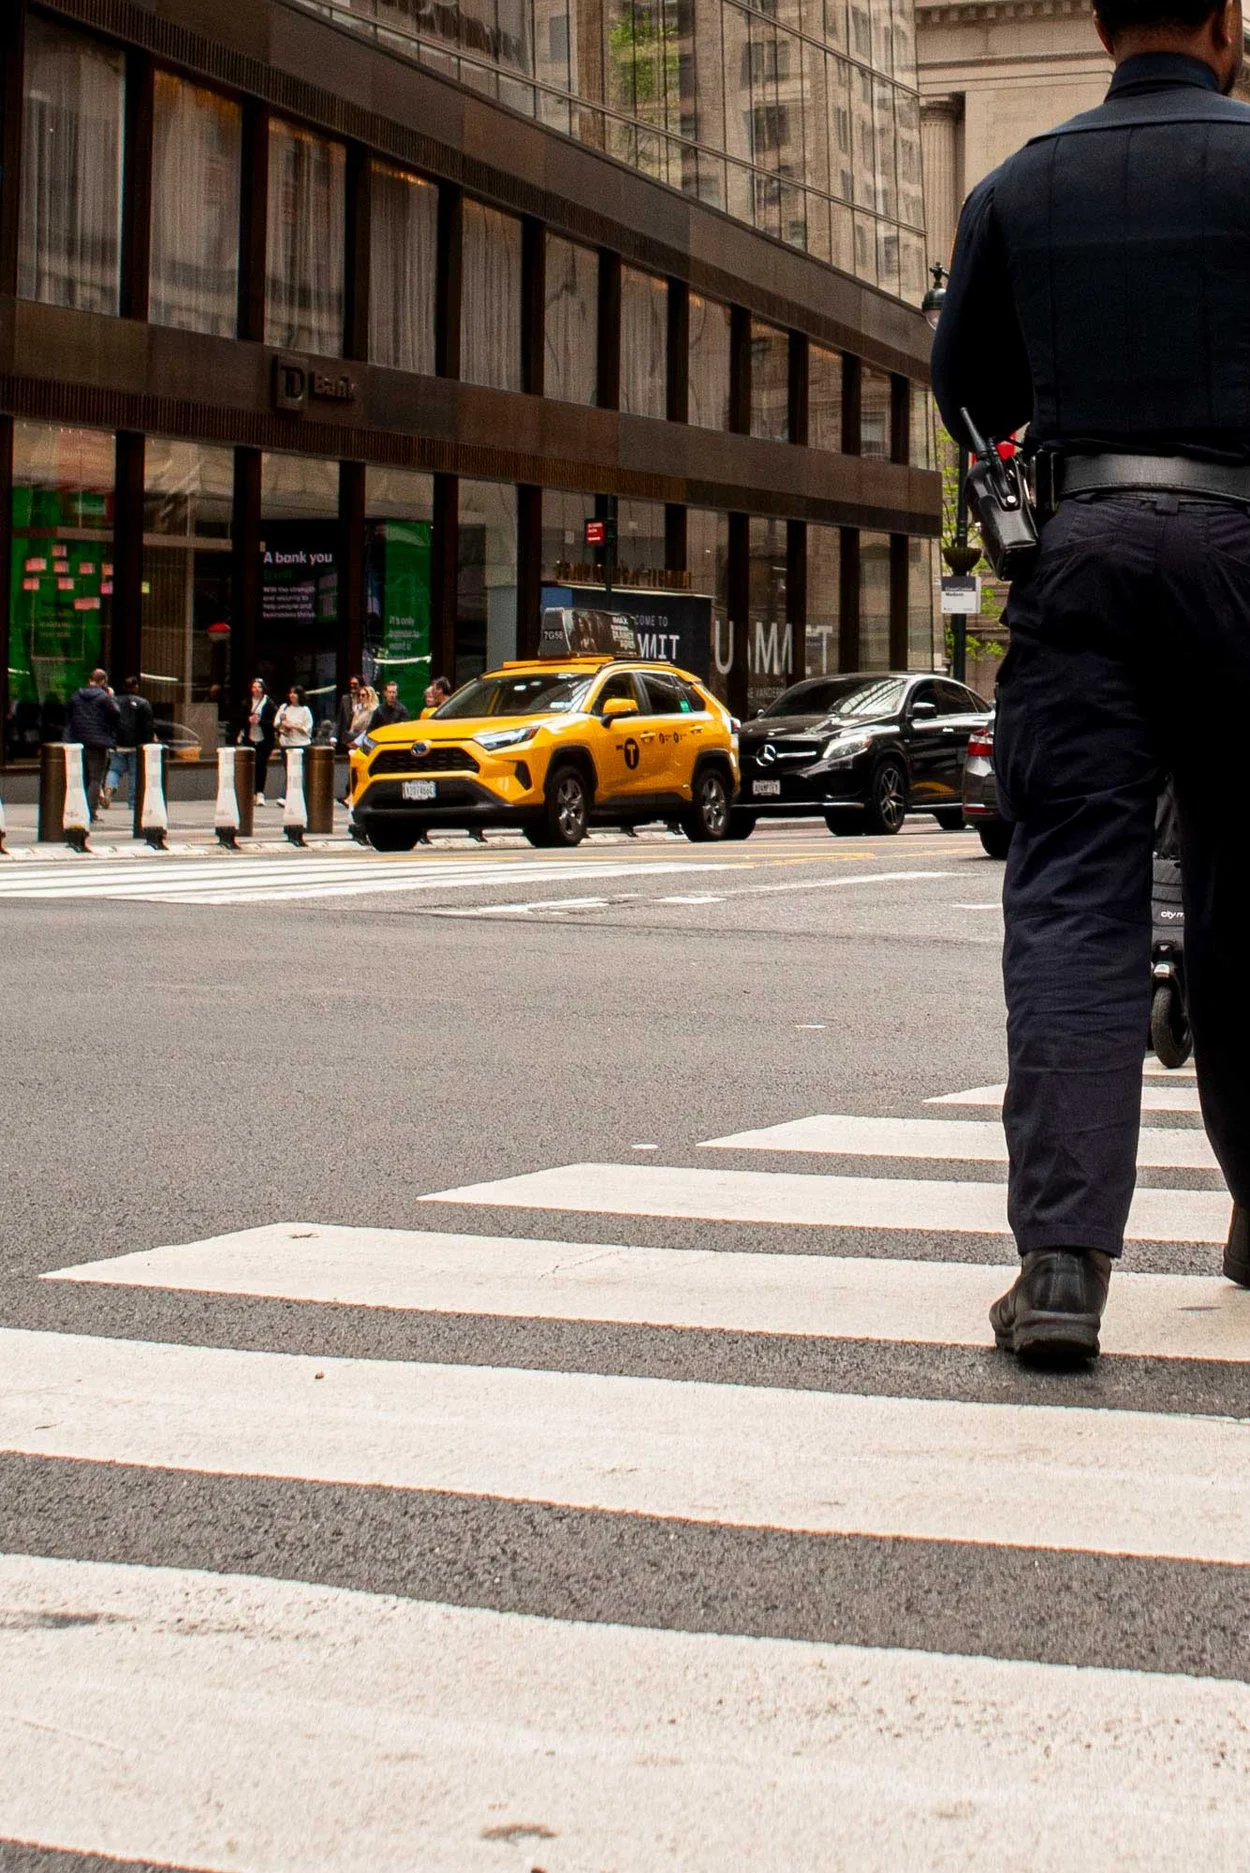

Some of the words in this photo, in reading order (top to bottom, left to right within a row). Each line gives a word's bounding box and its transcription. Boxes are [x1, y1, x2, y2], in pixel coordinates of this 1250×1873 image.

[263, 551, 273, 564] A
[275, 550, 307, 564] bank
[309, 553, 333, 566] you
[634, 614, 655, 627] COME
[658, 615, 669, 628] TO
